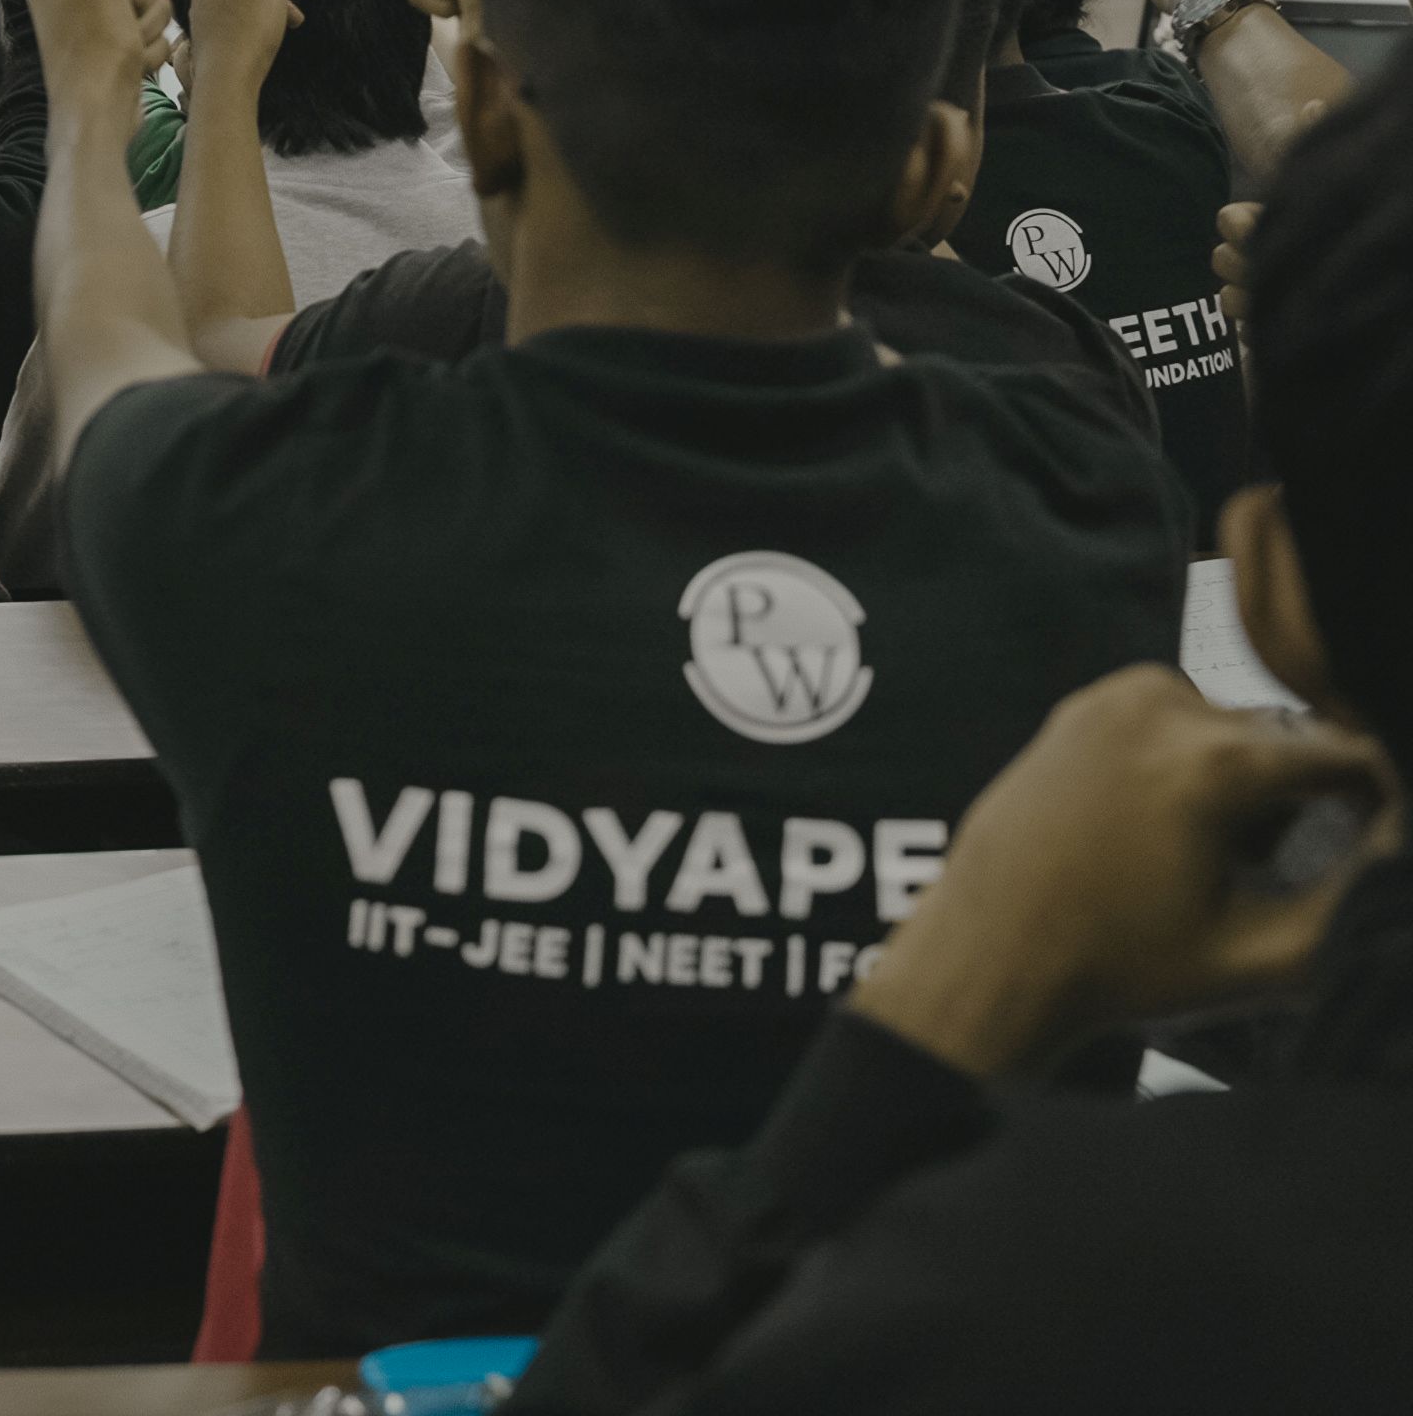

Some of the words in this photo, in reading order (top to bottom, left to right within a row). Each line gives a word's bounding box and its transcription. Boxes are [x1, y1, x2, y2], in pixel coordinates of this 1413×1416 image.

[328, 777, 948, 922] VIDYAPE
[347, 898, 573, 979] IIT-JEE
[617, 930, 775, 989] NEET
